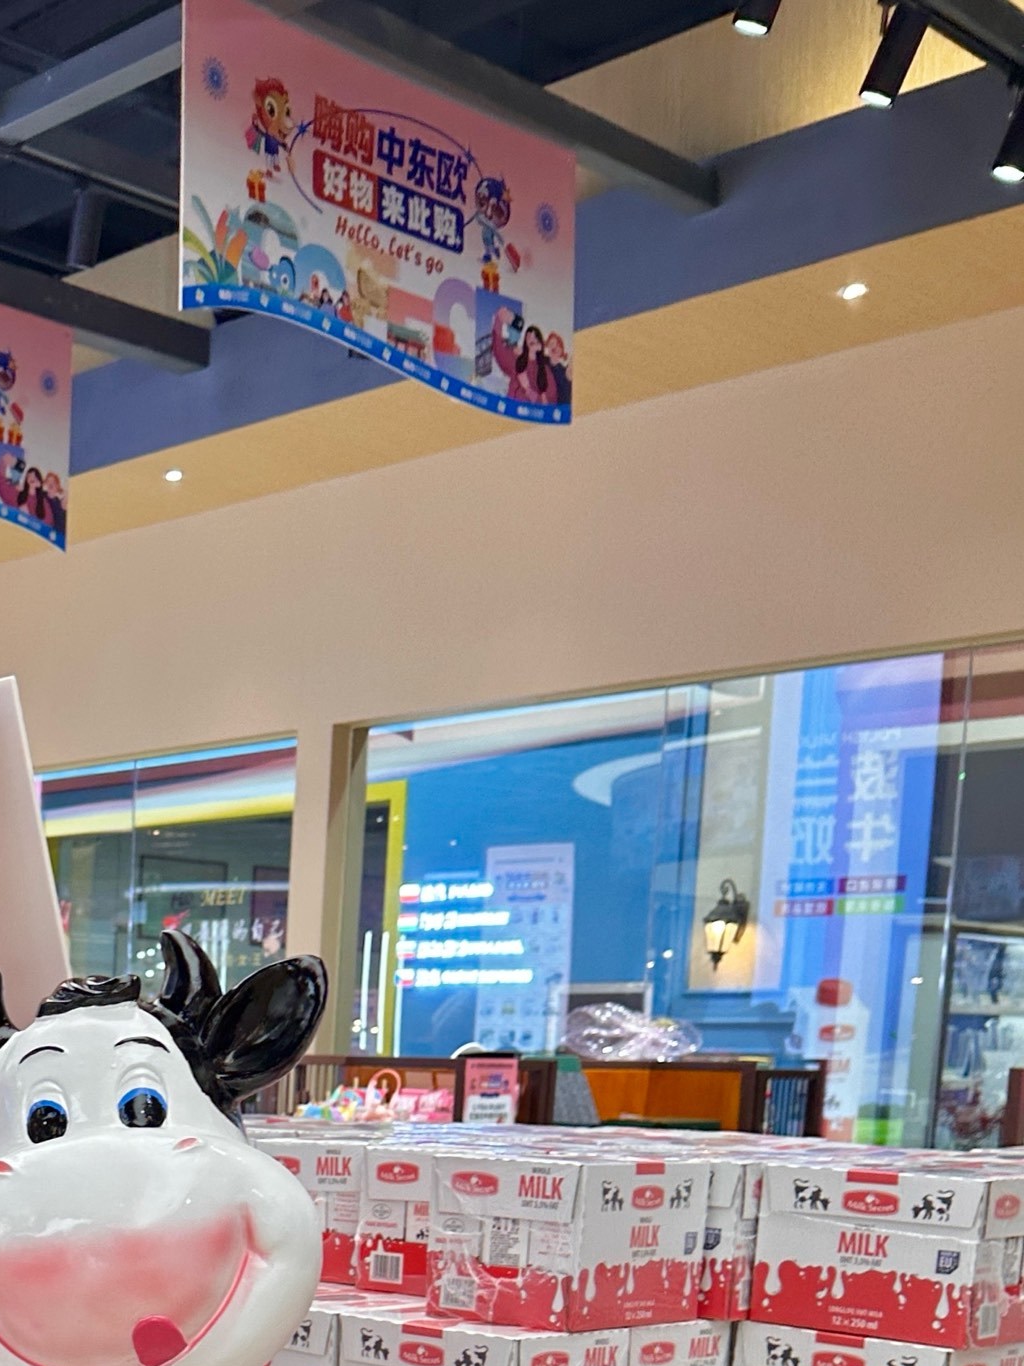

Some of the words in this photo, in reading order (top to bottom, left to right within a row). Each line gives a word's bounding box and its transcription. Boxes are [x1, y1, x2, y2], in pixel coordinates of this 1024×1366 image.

[425, 255, 445, 276] go
[316, 1157, 352, 1177] MILK
[518, 1174, 565, 1201] MILK
[847, 1200, 866, 1211] Milk
[866, 1202, 895, 1213] Secret
[629, 1225, 661, 1248] MILK
[837, 1232, 891, 1259] MILK
